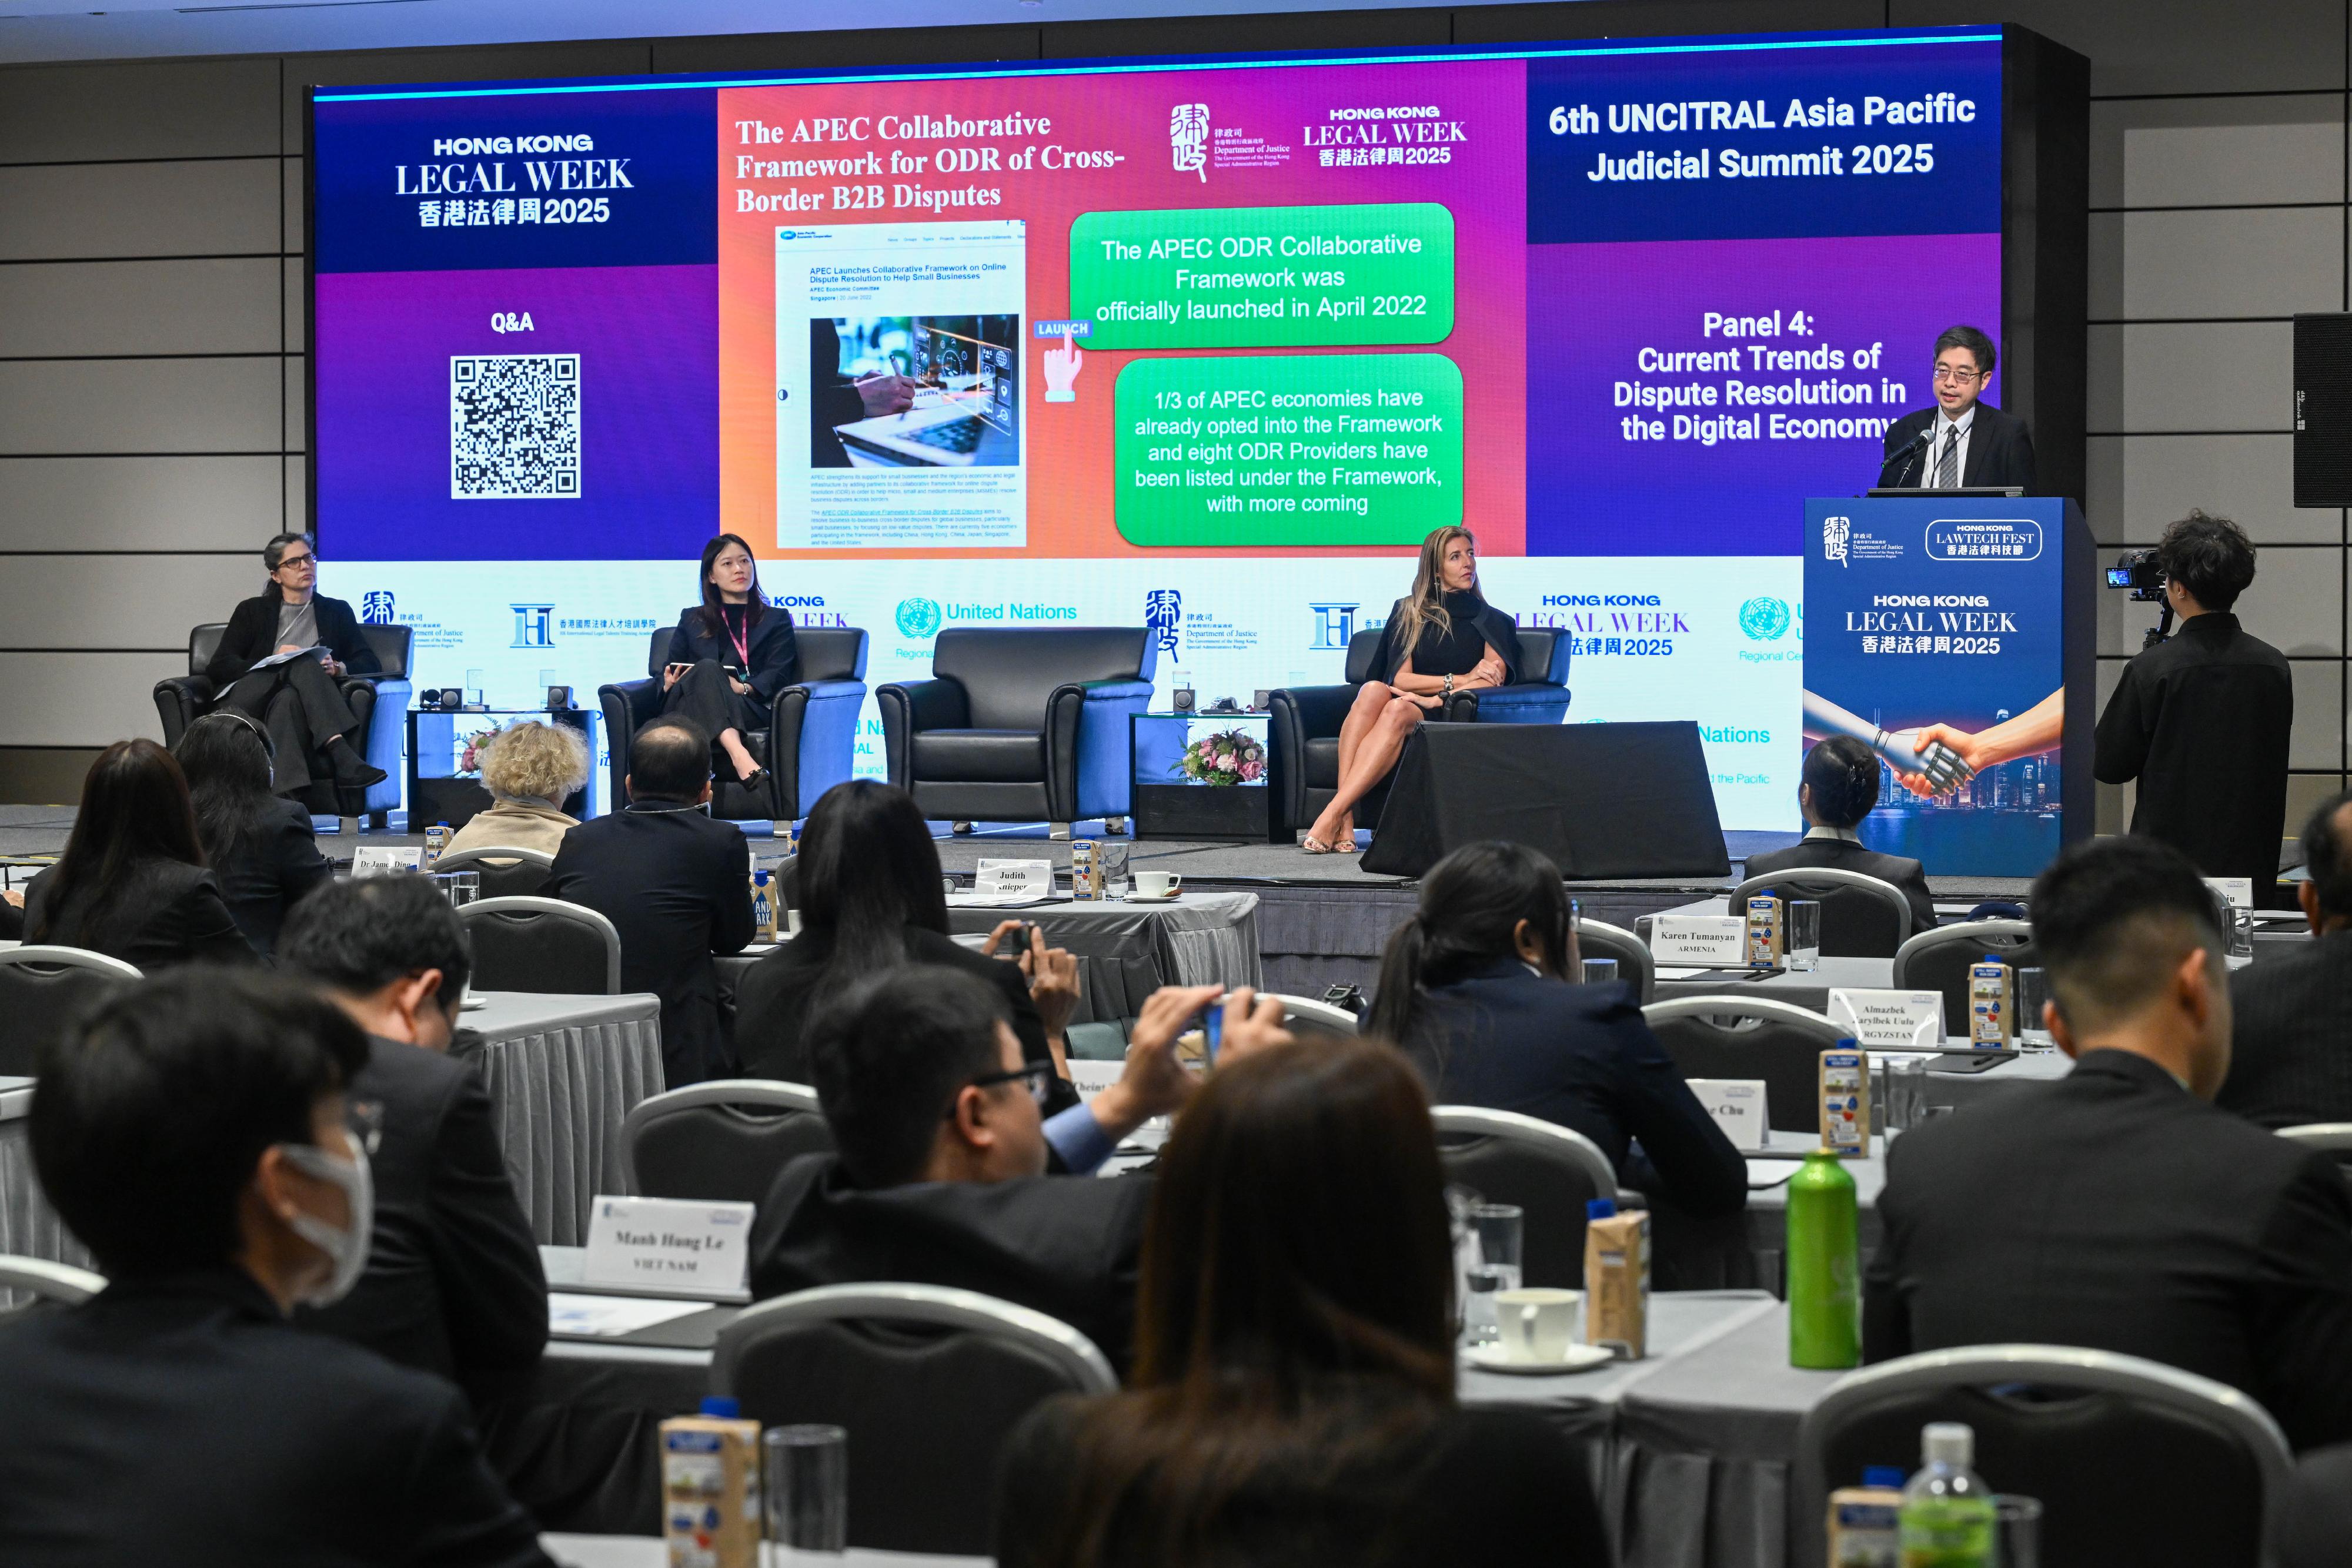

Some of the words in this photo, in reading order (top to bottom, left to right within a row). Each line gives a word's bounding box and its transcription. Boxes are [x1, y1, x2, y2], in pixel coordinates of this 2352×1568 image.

[1330, 108, 1384, 120] HONG
[1387, 106, 1439, 119] KONG
[1549, 105, 1599, 135] 6th
[1609, 101, 1775, 133] UNCITRAL
[1783, 97, 1854, 127] Asia
[1865, 92, 1975, 125] Pacific
[736, 121, 783, 143] The
[791, 117, 869, 142] APEC
[878, 112, 1050, 139] Collaborative
[1215, 128, 1241, 138] 律政司
[1304, 125, 1387, 146] LEGAL
[1392, 122, 1467, 143] WEEK
[434, 137, 513, 156] HONG
[517, 134, 593, 153] KONG
[1215, 147, 1255, 155] Department
[736, 152, 883, 178] Framework
[890, 150, 928, 173] for
[936, 148, 1001, 172] ODR
[1009, 146, 1036, 170] of
[1041, 145, 1124, 169] Cross-
[1319, 147, 1451, 166] 香港法律周2025
[1588, 149, 1709, 181] Judicial
[1719, 146, 1843, 178] Summit
[1852, 143, 1933, 173] 2025
[396, 163, 515, 194] LEGAL
[523, 159, 634, 191] WEEK
[736, 188, 824, 212] Border
[832, 185, 884, 209] B2B
[893, 184, 1000, 213] Disputes
[419, 198, 610, 227] 香港法律周2025
[1101, 240, 1141, 260] The
[1148, 238, 1212, 259] APEC
[1220, 237, 1272, 258] ODR
[1279, 234, 1421, 256] Collaborative
[1176, 268, 1295, 289] Framework
[1302, 271, 1345, 286] was
[1097, 300, 1181, 324] officially
[1188, 298, 1284, 319] launched
[1292, 297, 1309, 317] in
[1317, 296, 1364, 321] April
[1372, 295, 1426, 315] 2022
[491, 312, 534, 334] Q&A
[1038, 323, 1088, 335] LAUNCH
[1705, 310, 1780, 337] Panel
[1788, 311, 1813, 335] 4:
[1639, 347, 1740, 372] Current
[1748, 343, 1845, 370] Trends
[1853, 342, 1882, 369] of
[1155, 392, 1181, 409] 1/3
[1188, 392, 1205, 409] of
[1210, 390, 1265, 408] APEC
[1272, 389, 1371, 407] economies
[1378, 389, 1423, 406] have
[1615, 381, 1717, 412] Dispute
[1726, 378, 1872, 405] Resolution
[1882, 377, 1905, 403] in
[1135, 417, 1202, 439] already
[1207, 416, 1258, 438] opted
[1265, 416, 1298, 433] into
[1303, 416, 1332, 433] the
[1339, 414, 1442, 433] Framework
[1621, 414, 1665, 440] the
[1674, 413, 1759, 446] Digital
[1148, 443, 1182, 461] and
[1188, 443, 1232, 464] eight
[1238, 442, 1284, 460] ODR
[1291, 442, 1377, 459] Providers
[1384, 442, 1428, 458] have
[1136, 470, 1180, 486] been
[1187, 469, 1233, 486] listed
[1240, 469, 1292, 486] under
[1298, 469, 1326, 485] the
[1333, 467, 1441, 487] Framework,
[1207, 495, 1242, 511] with
[1250, 499, 1296, 511] more
[1301, 494, 1368, 516] coming
[1937, 534, 1999, 543] LAWTECH
[2003, 534, 2034, 543] FEST
[1947, 545, 2023, 555] 香港法律科技節
[774, 597, 824, 606] KONG
[947, 603, 1003, 619] United
[1010, 603, 1077, 619] Nations
[1543, 596, 1600, 606] HONG
[1605, 596, 1661, 606] KONG
[1874, 596, 1930, 606] HONG
[1934, 596, 1989, 607] KONG
[1611, 613, 1689, 632] WEEK
[1846, 612, 1932, 631] LEGAL
[1939, 613, 2018, 632] WEEK
[896, 648, 933, 660] Regiona
[1862, 636, 2000, 654] 香港法律周2025
[1739, 651, 1783, 663] Regional
[1718, 774, 1734, 783] the
[1736, 773, 1769, 784] Pacific
[1690, 932, 1735, 942] Tumanyan
[1719, 1105, 1744, 1115] Chu
